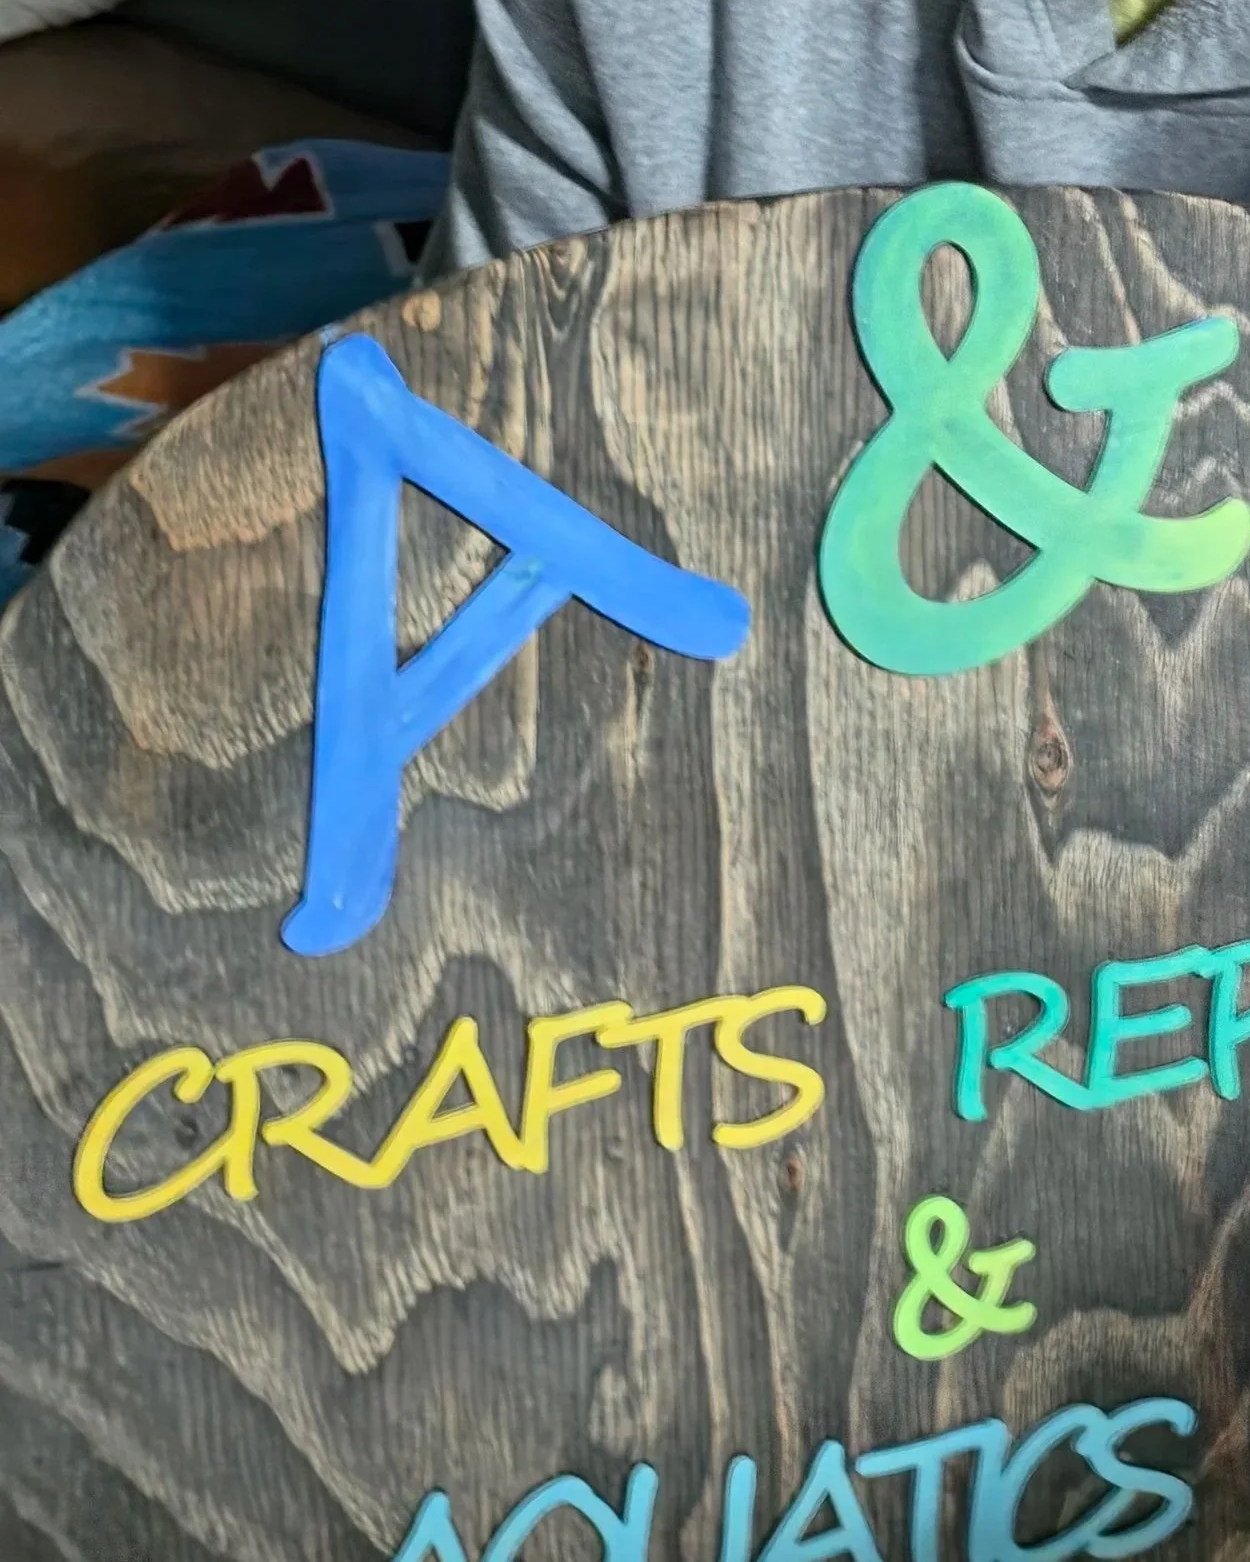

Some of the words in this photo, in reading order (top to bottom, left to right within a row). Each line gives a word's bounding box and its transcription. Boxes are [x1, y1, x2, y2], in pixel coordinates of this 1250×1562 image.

[281, 333, 751, 956] A
[74, 985, 826, 1222] CRAFTS
[893, 1195, 1037, 1361] &
